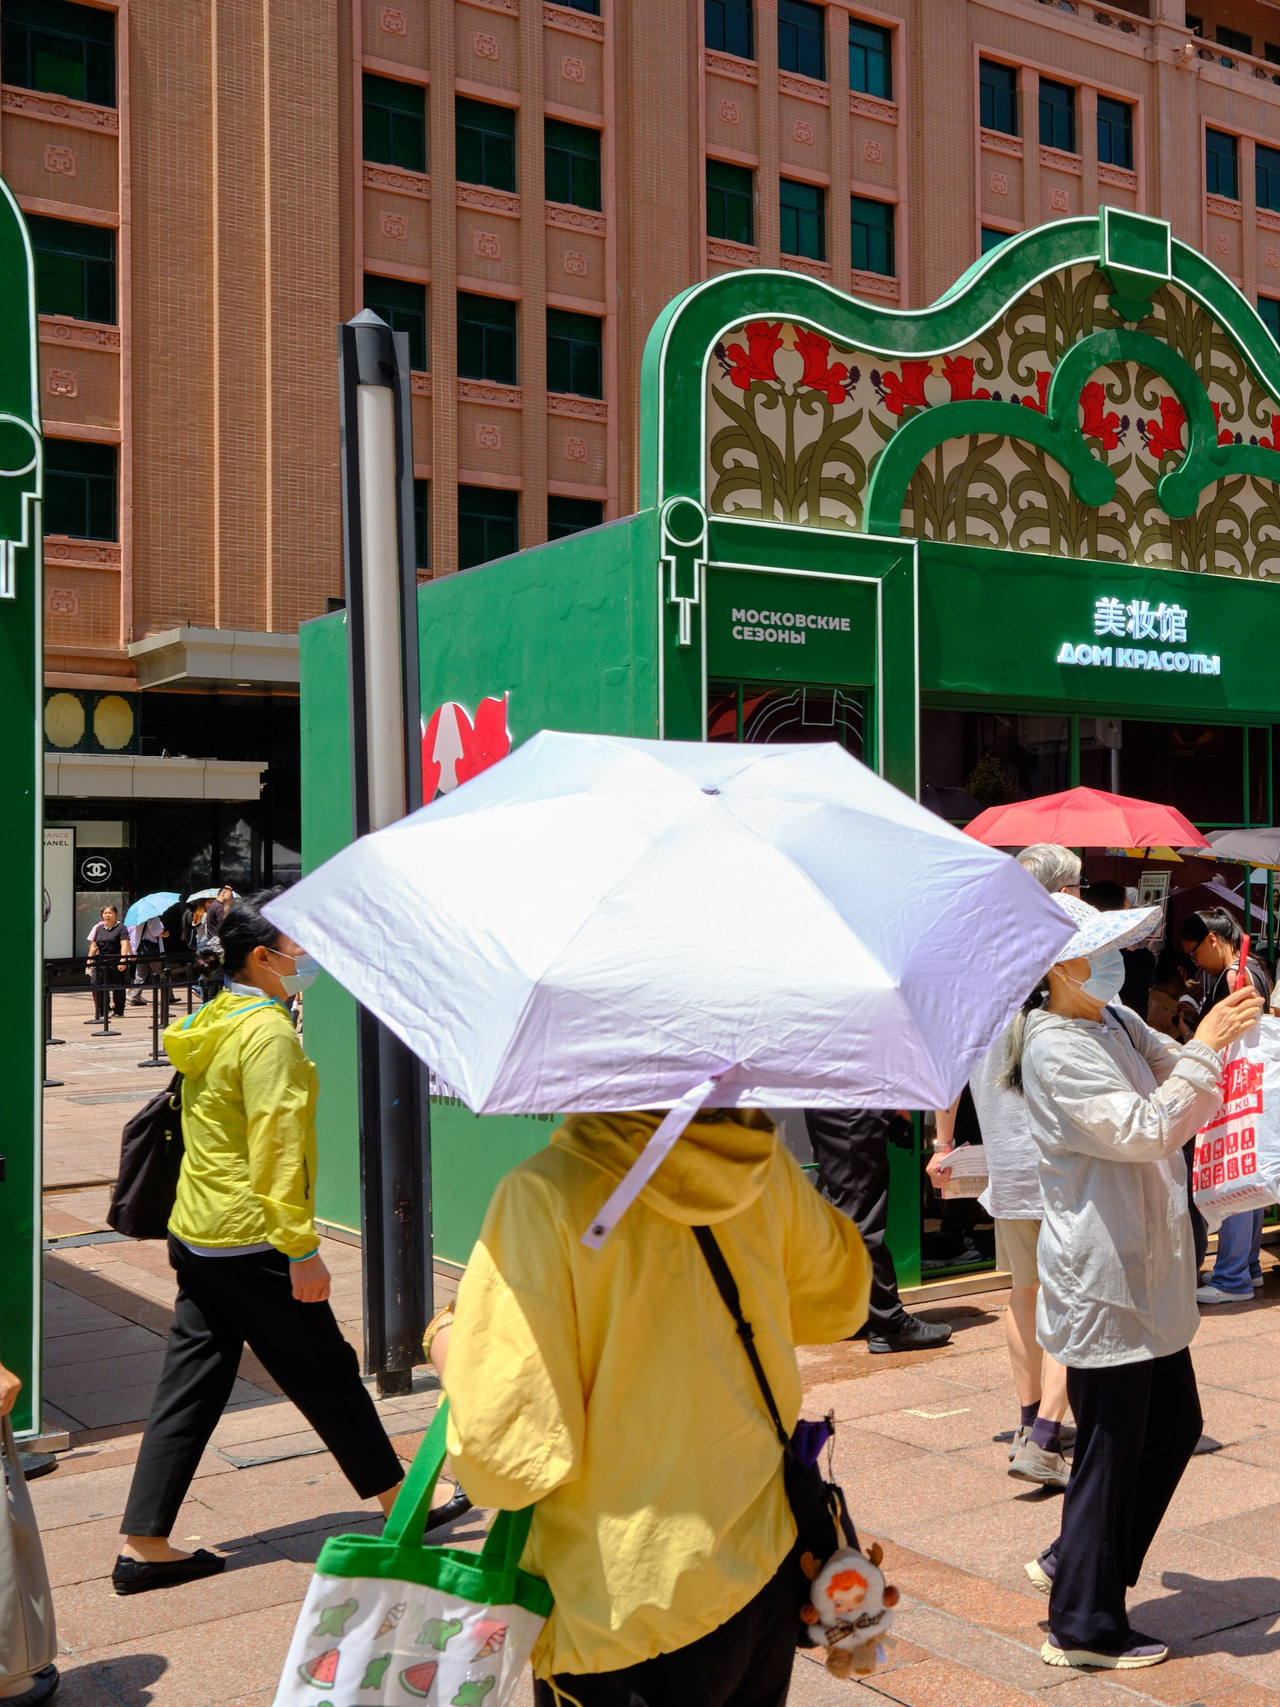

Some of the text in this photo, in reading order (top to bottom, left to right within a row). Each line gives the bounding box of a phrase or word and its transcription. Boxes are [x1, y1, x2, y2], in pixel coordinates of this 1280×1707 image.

[732, 608, 850, 631] МОСКОВСКИЕ
[1093, 596, 1188, 643] 美妆馆
[732, 626, 805, 644] СЕЗОНЫ
[1057, 642, 1221, 675] ДОМ КРАСОТЫ
